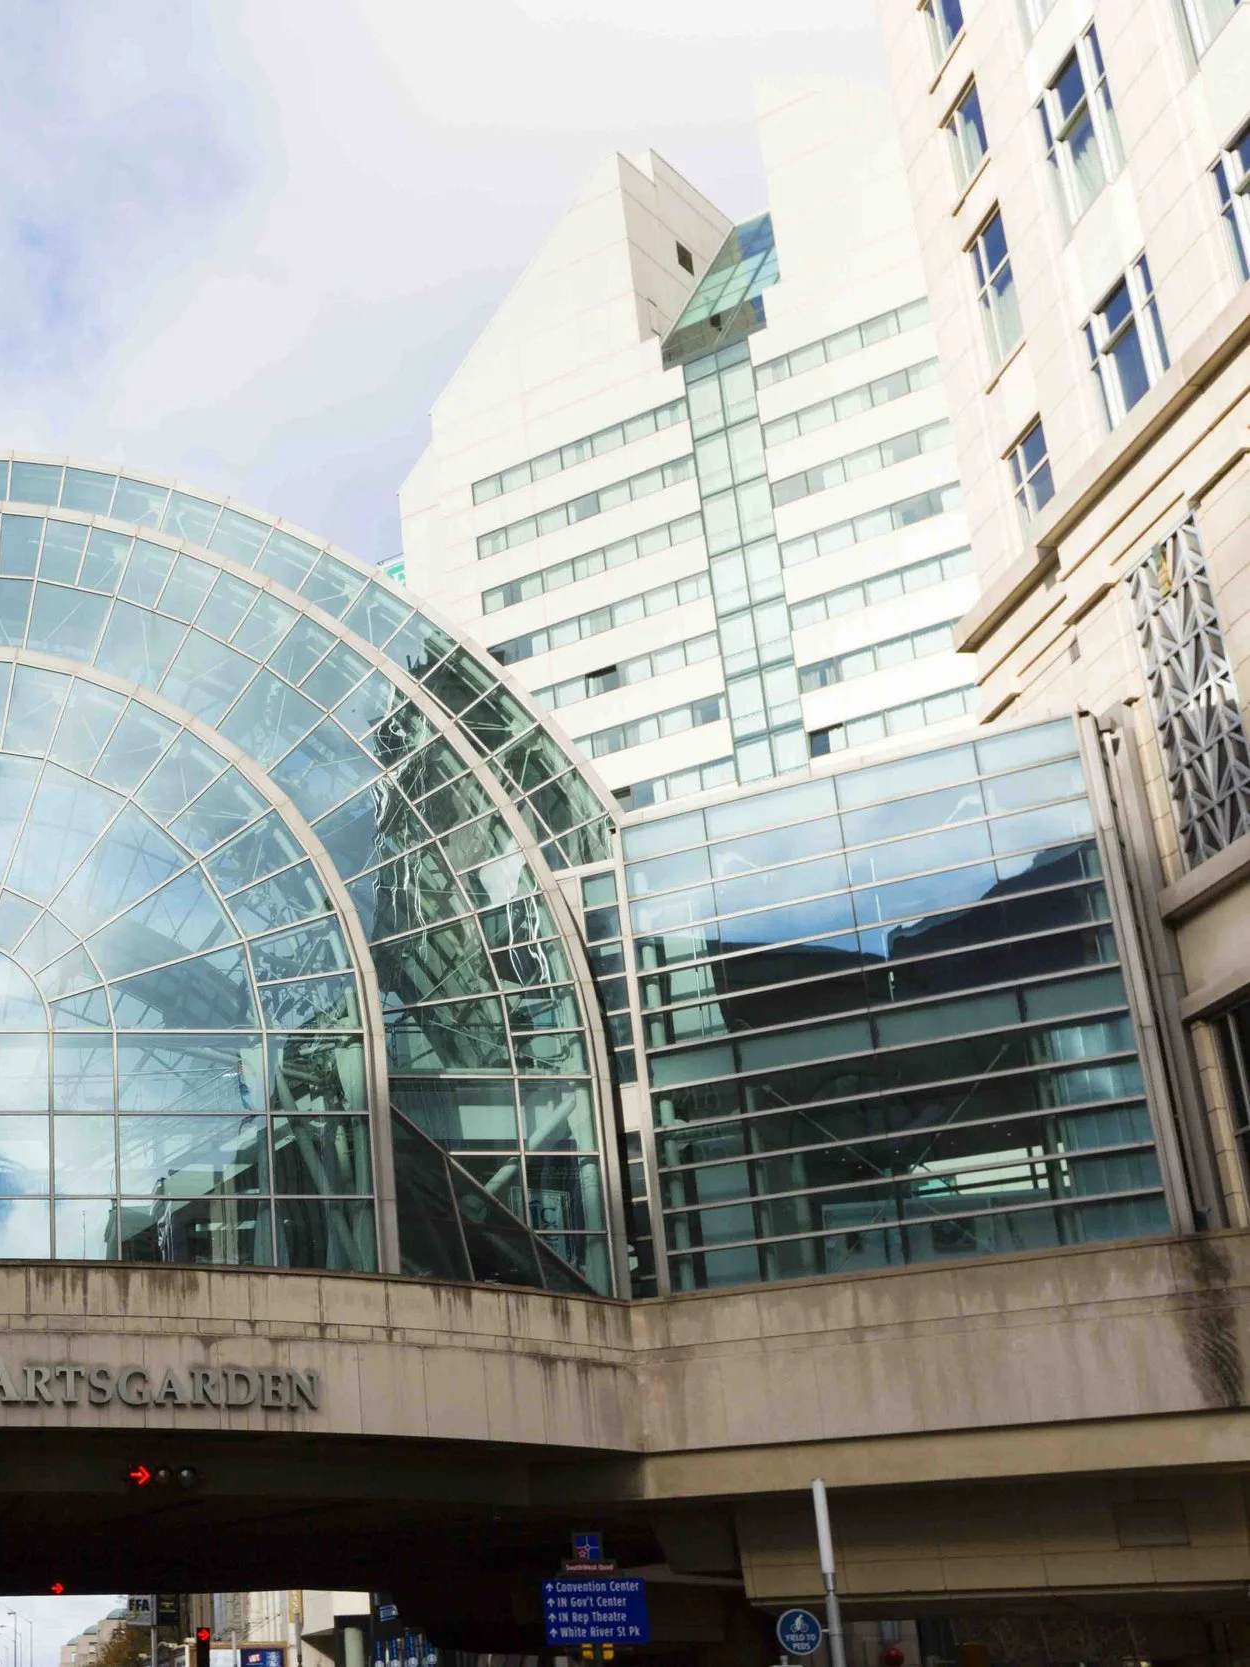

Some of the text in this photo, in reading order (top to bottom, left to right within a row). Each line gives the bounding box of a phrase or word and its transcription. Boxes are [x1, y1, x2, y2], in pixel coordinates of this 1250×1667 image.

[555, 1580, 640, 1593] Convention Center
[557, 1596, 627, 1608] IN Gov't Center
[558, 1611, 627, 1624] IN Rep Theatre
[559, 1625, 641, 1638] White River St Pk
[785, 1633, 817, 1642] YIELD TO
